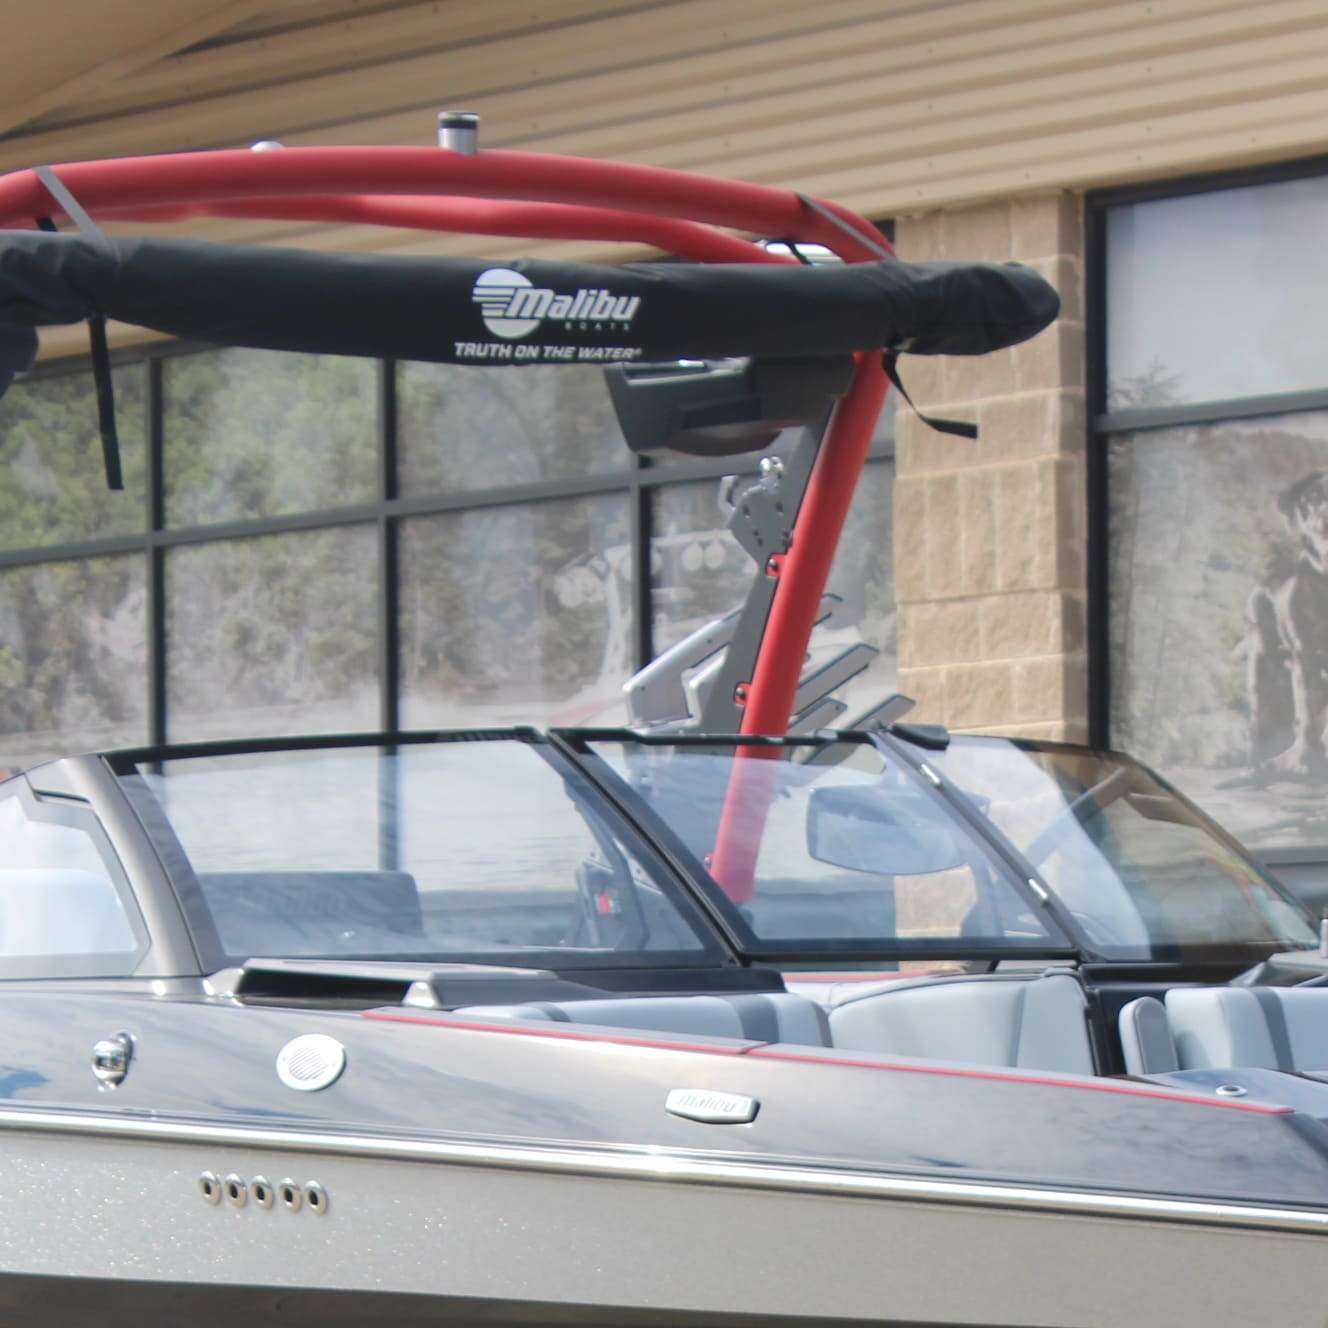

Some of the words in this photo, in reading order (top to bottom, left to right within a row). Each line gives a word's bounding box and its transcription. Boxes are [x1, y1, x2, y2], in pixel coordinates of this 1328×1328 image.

[504, 288, 641, 321] Malibu
[564, 321, 630, 331] BOATS
[454, 342, 510, 358] TRUTH
[514, 344, 540, 359] ON
[543, 345, 574, 359] THE
